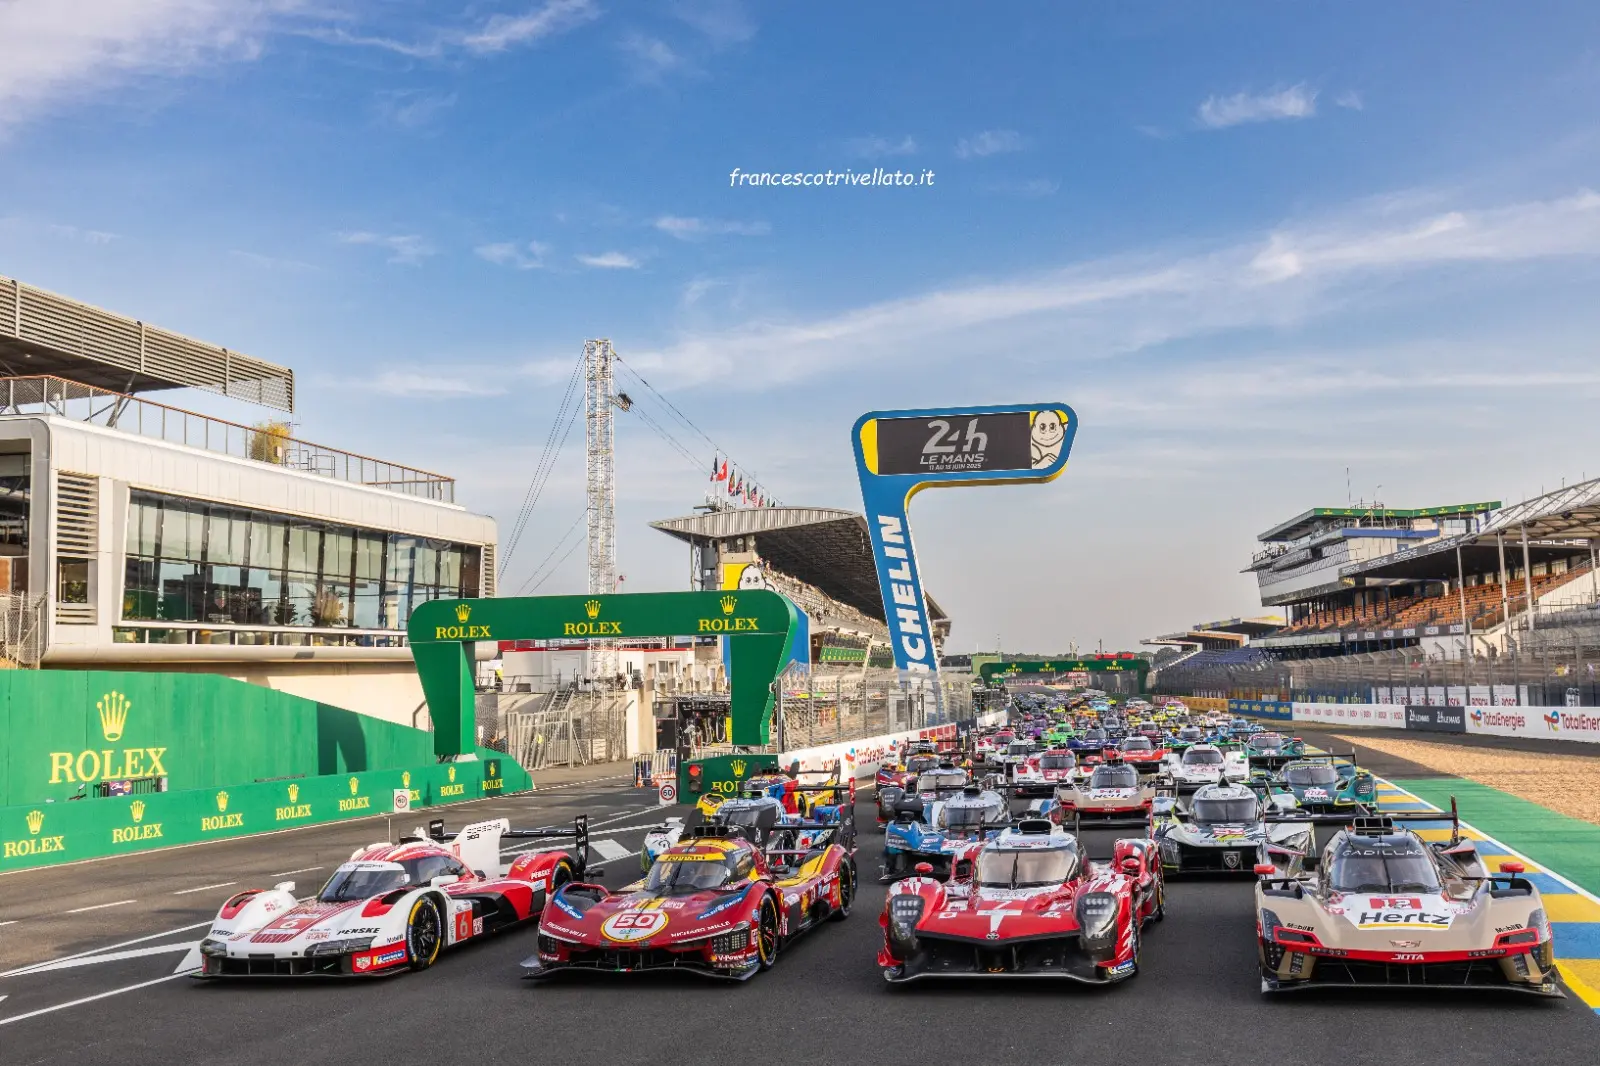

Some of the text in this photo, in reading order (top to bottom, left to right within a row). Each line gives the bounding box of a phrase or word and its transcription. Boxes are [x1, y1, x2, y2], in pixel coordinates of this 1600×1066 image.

[922, 418, 988, 453] 24h
[920, 453, 985, 464] LE MANS
[435, 625, 490, 639] ROLEX
[564, 621, 622, 635] ROLEX
[699, 617, 758, 632] ROLEX
[1482, 711, 1525, 731] TotalEnergies
[49, 748, 168, 783] ROLEX
[440, 783, 464, 797] ROLEX
[482, 778, 503, 791] ROLEX
[276, 804, 312, 820] ROLEX
[339, 797, 370, 812] ROLEX
[202, 813, 243, 831] ROLEX
[113, 823, 163, 843] ROLEX
[4, 836, 64, 858] ROLEX
[1342, 849, 1425, 857] CADILLAC
[281, 917, 299, 929] 6
[460, 913, 469, 938] 6
[615, 913, 656, 927] 50
[1359, 911, 1449, 925] Hertz
[338, 927, 381, 936] PENSKE
[670, 921, 731, 938] RICHARD MILLE
